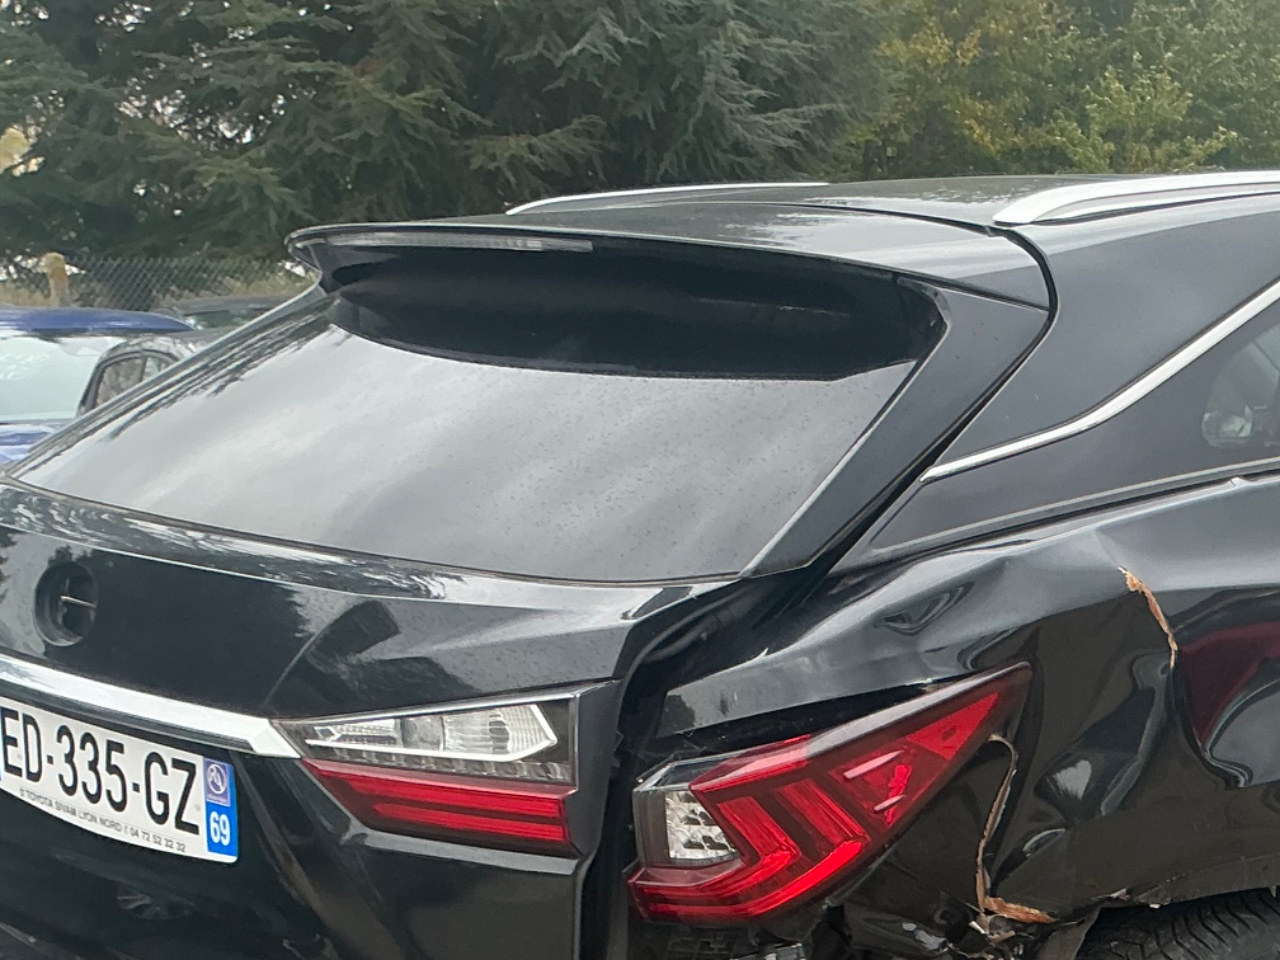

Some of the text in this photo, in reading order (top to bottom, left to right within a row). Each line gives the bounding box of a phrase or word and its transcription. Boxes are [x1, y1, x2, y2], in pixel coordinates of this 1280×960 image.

[0, 705, 200, 836] ED-335-GZ
[25, 790, 53, 808] TOYOTA
[78, 810, 98, 824] LYON
[99, 817, 123, 832] NORD
[141, 830, 151, 842] 72
[210, 811, 230, 846] 69
